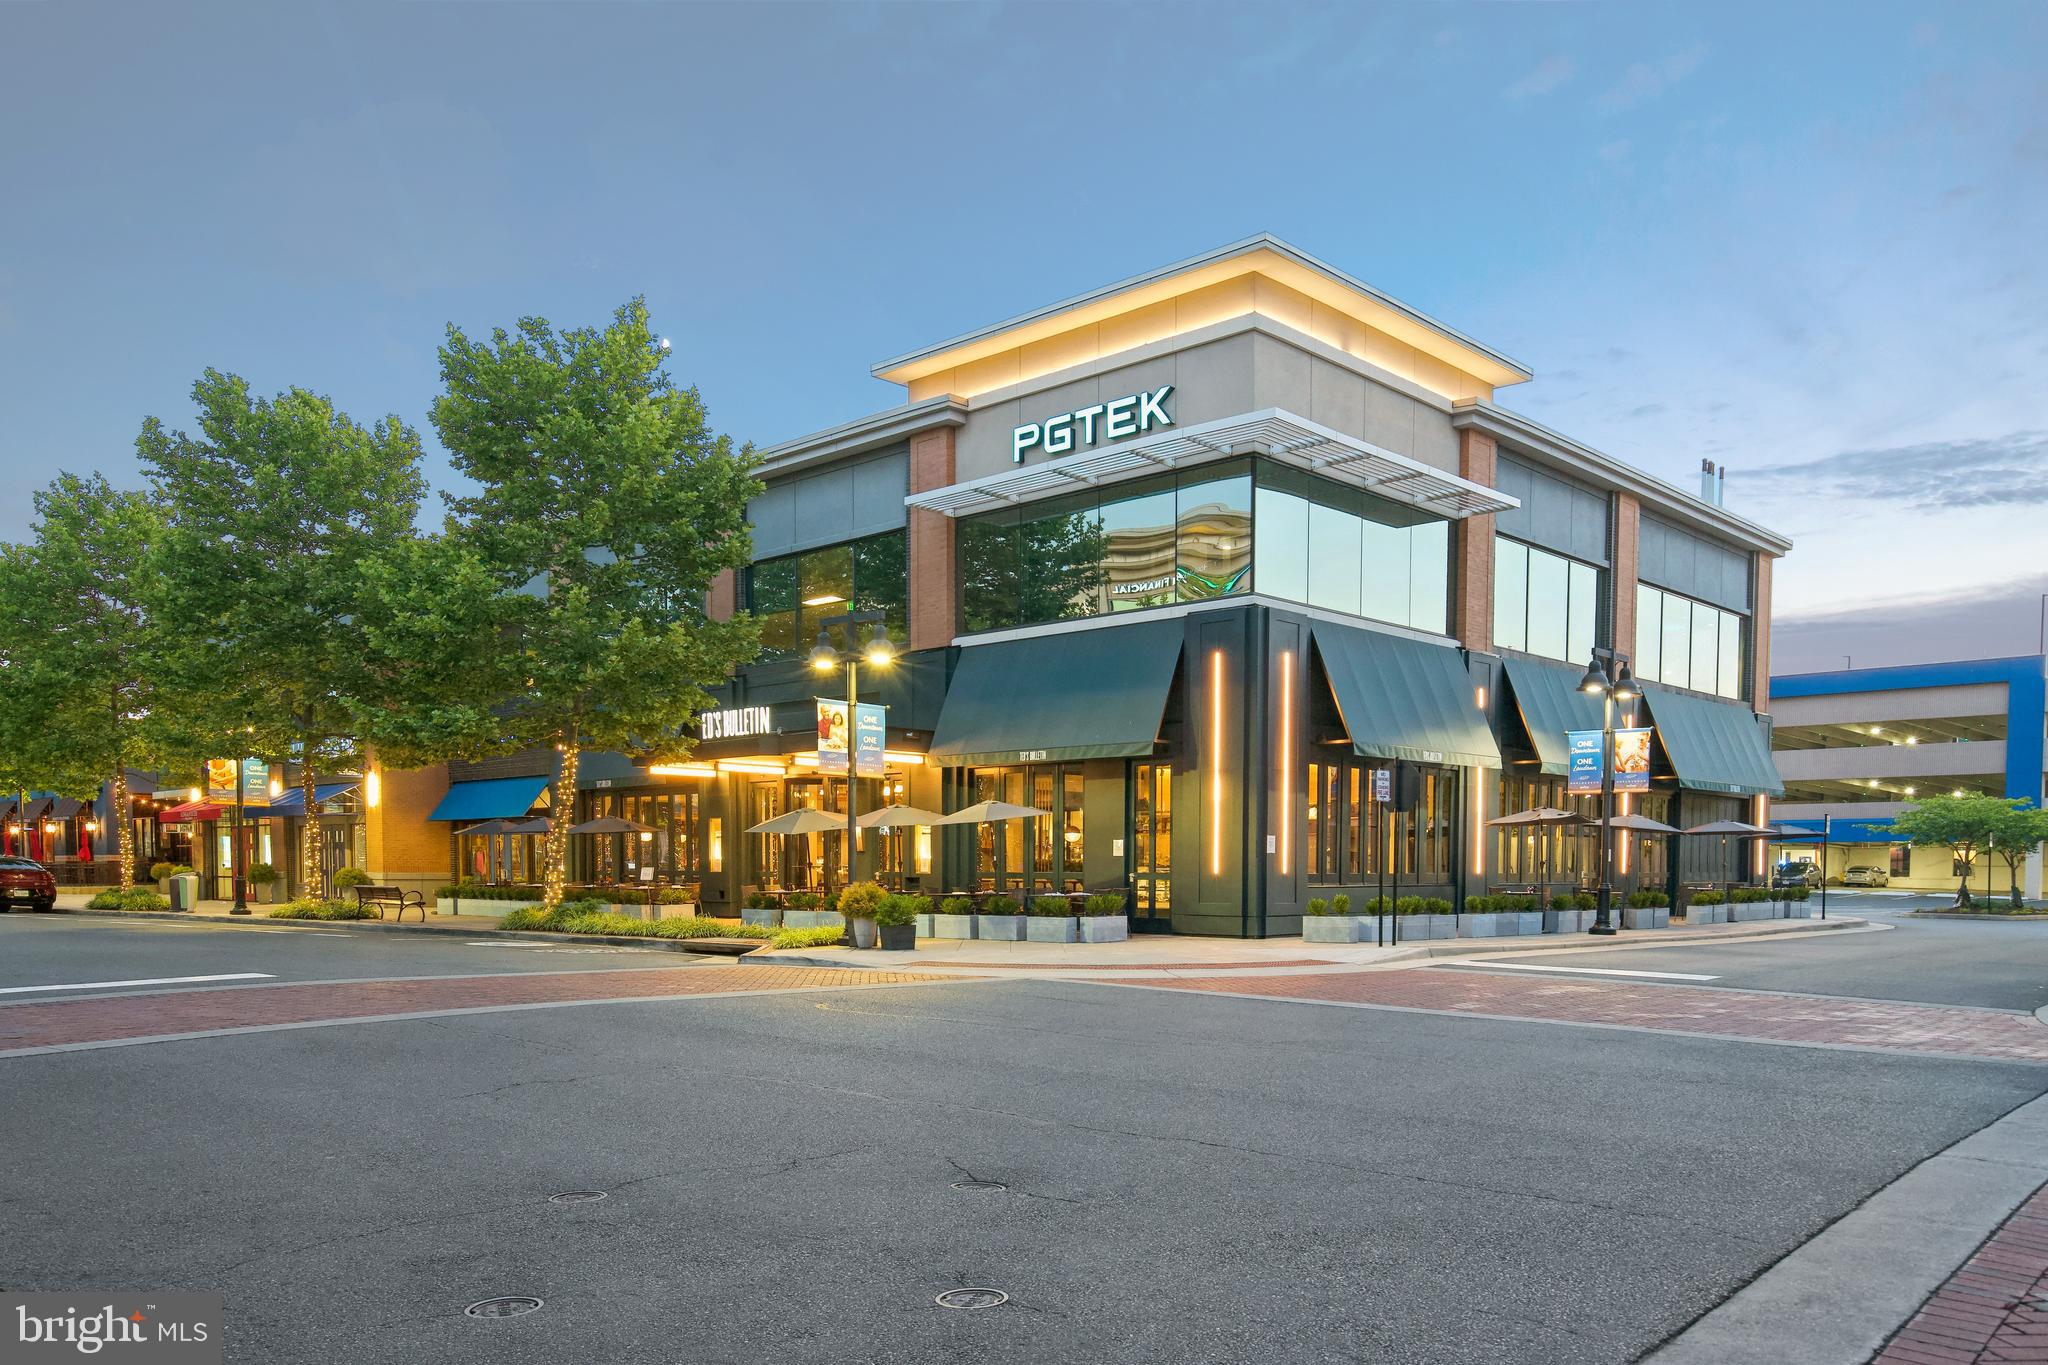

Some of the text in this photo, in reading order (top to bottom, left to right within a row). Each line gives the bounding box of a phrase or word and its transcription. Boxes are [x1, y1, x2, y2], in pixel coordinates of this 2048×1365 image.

[1012, 385, 1175, 463] PGTEK
[701, 706, 770, 740] ED'S BULLETIN
[863, 715, 878, 724] ONE
[863, 735, 878, 744] ONE
